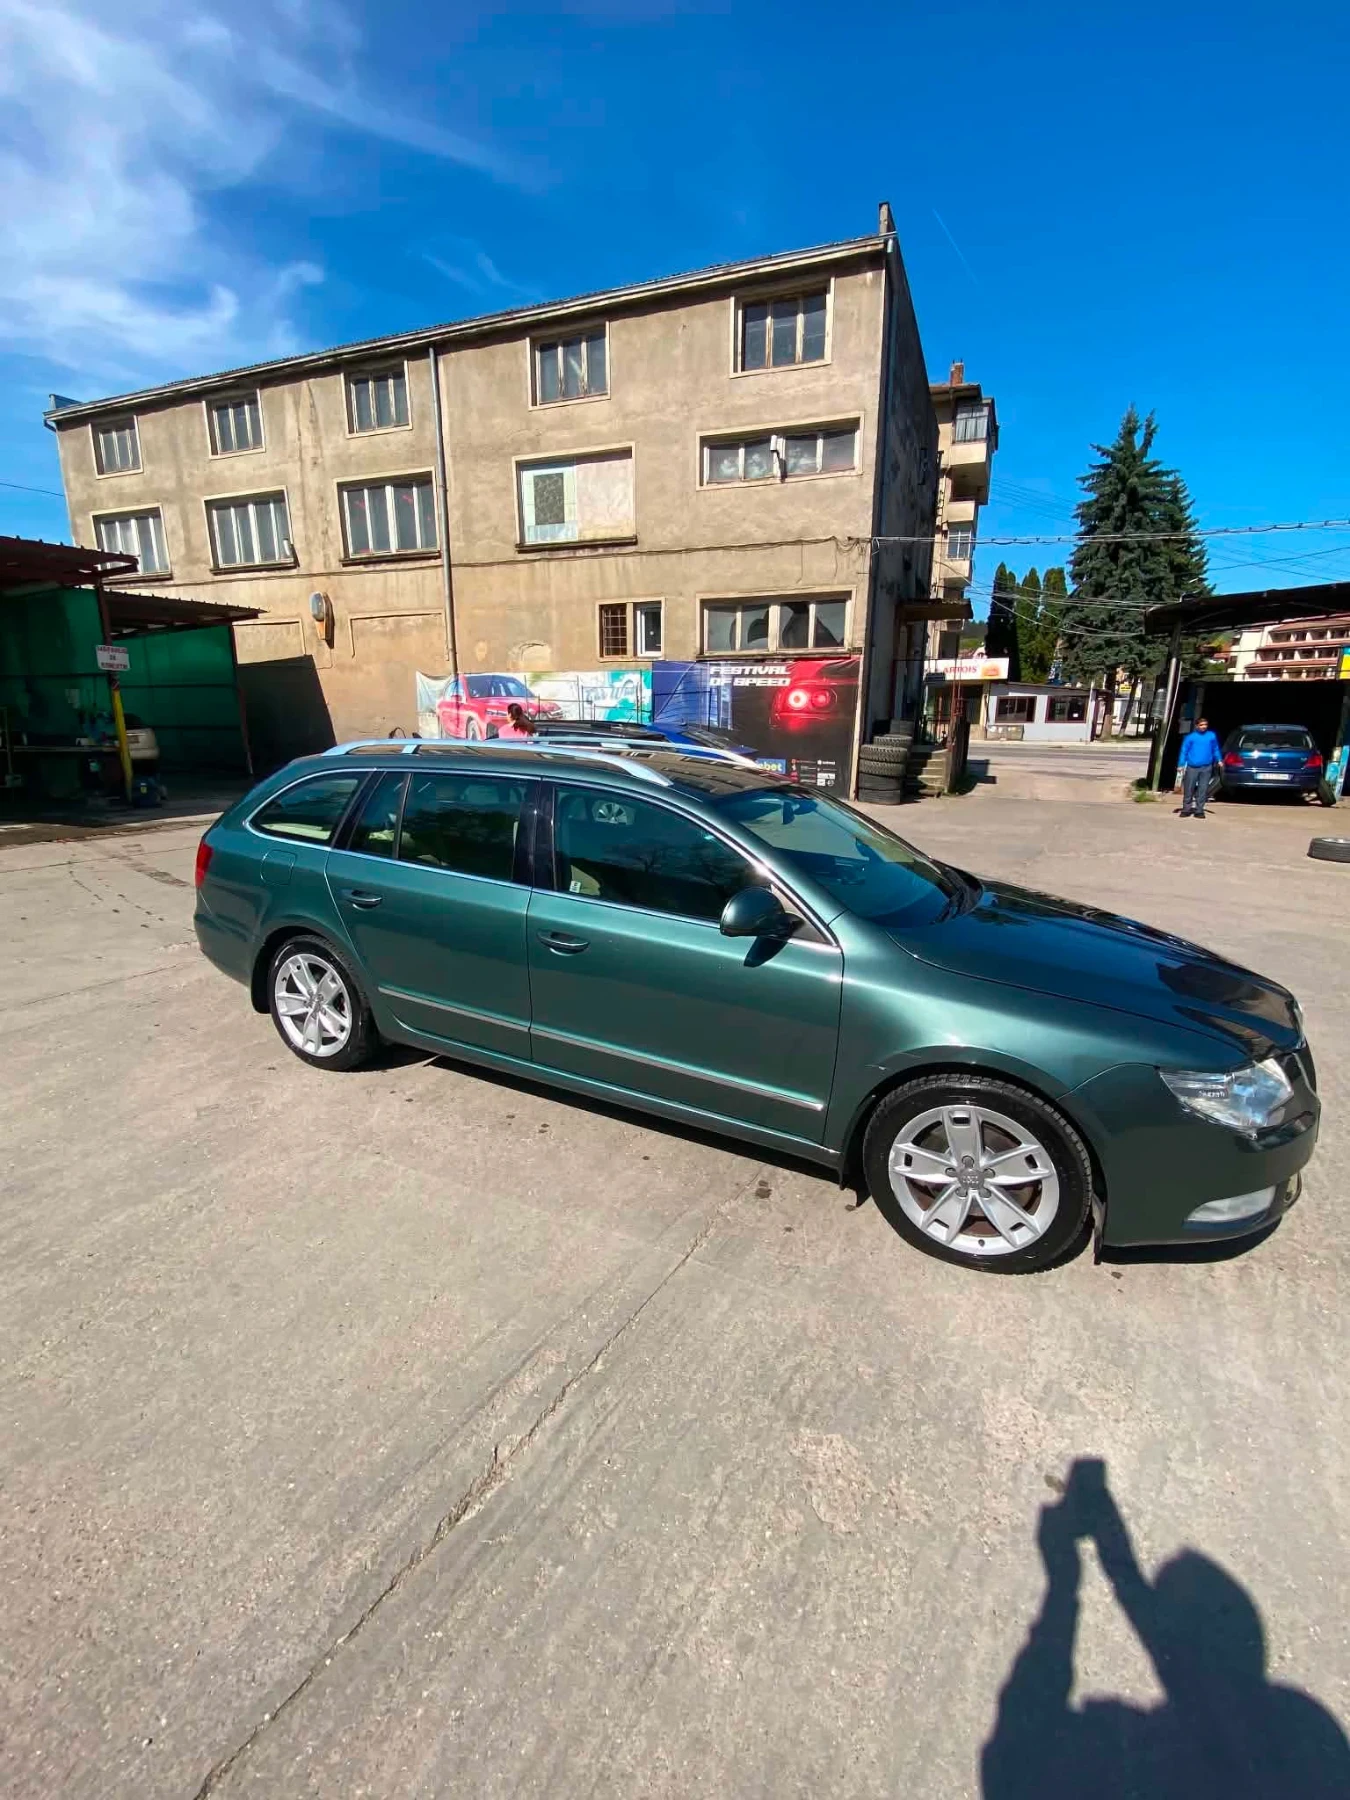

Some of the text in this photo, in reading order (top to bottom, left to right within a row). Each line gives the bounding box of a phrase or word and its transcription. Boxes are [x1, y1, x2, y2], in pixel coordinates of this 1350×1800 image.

[709, 665, 791, 675] FESTIVAL
[943, 665, 977, 674] ARTOIS
[709, 677, 792, 687] OF SPEED
